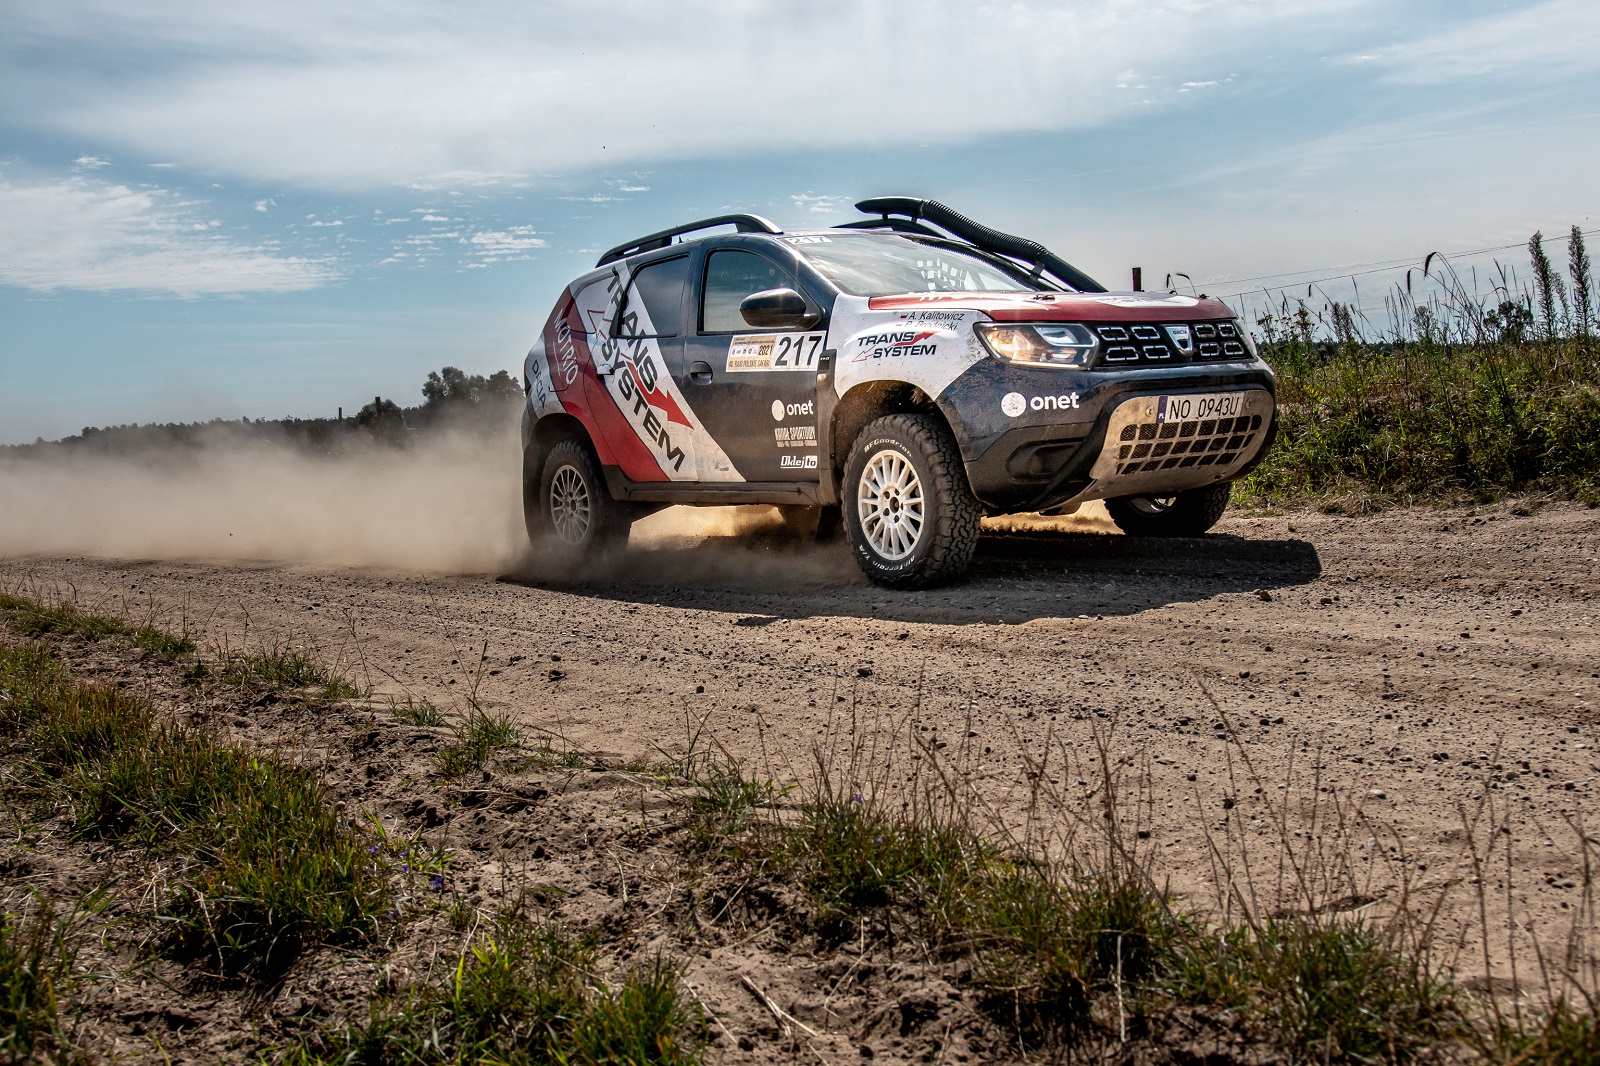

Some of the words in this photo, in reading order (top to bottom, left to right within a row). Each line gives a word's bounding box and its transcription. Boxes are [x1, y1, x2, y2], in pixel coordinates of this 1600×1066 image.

[908, 311, 917, 321] A.
[919, 310, 965, 321] Kalitowicz
[857, 332, 915, 347] TRANS
[758, 344, 775, 356] 2021
[775, 335, 822, 366] 217
[873, 344, 937, 359] SYSTEM
[602, 335, 686, 473] SYSTEM
[786, 400, 814, 416] onet
[1030, 391, 1080, 411] onet
[1169, 399, 1191, 420] NO
[1198, 397, 1240, 418] 0943U
[864, 438, 912, 457] BFGoodrich
